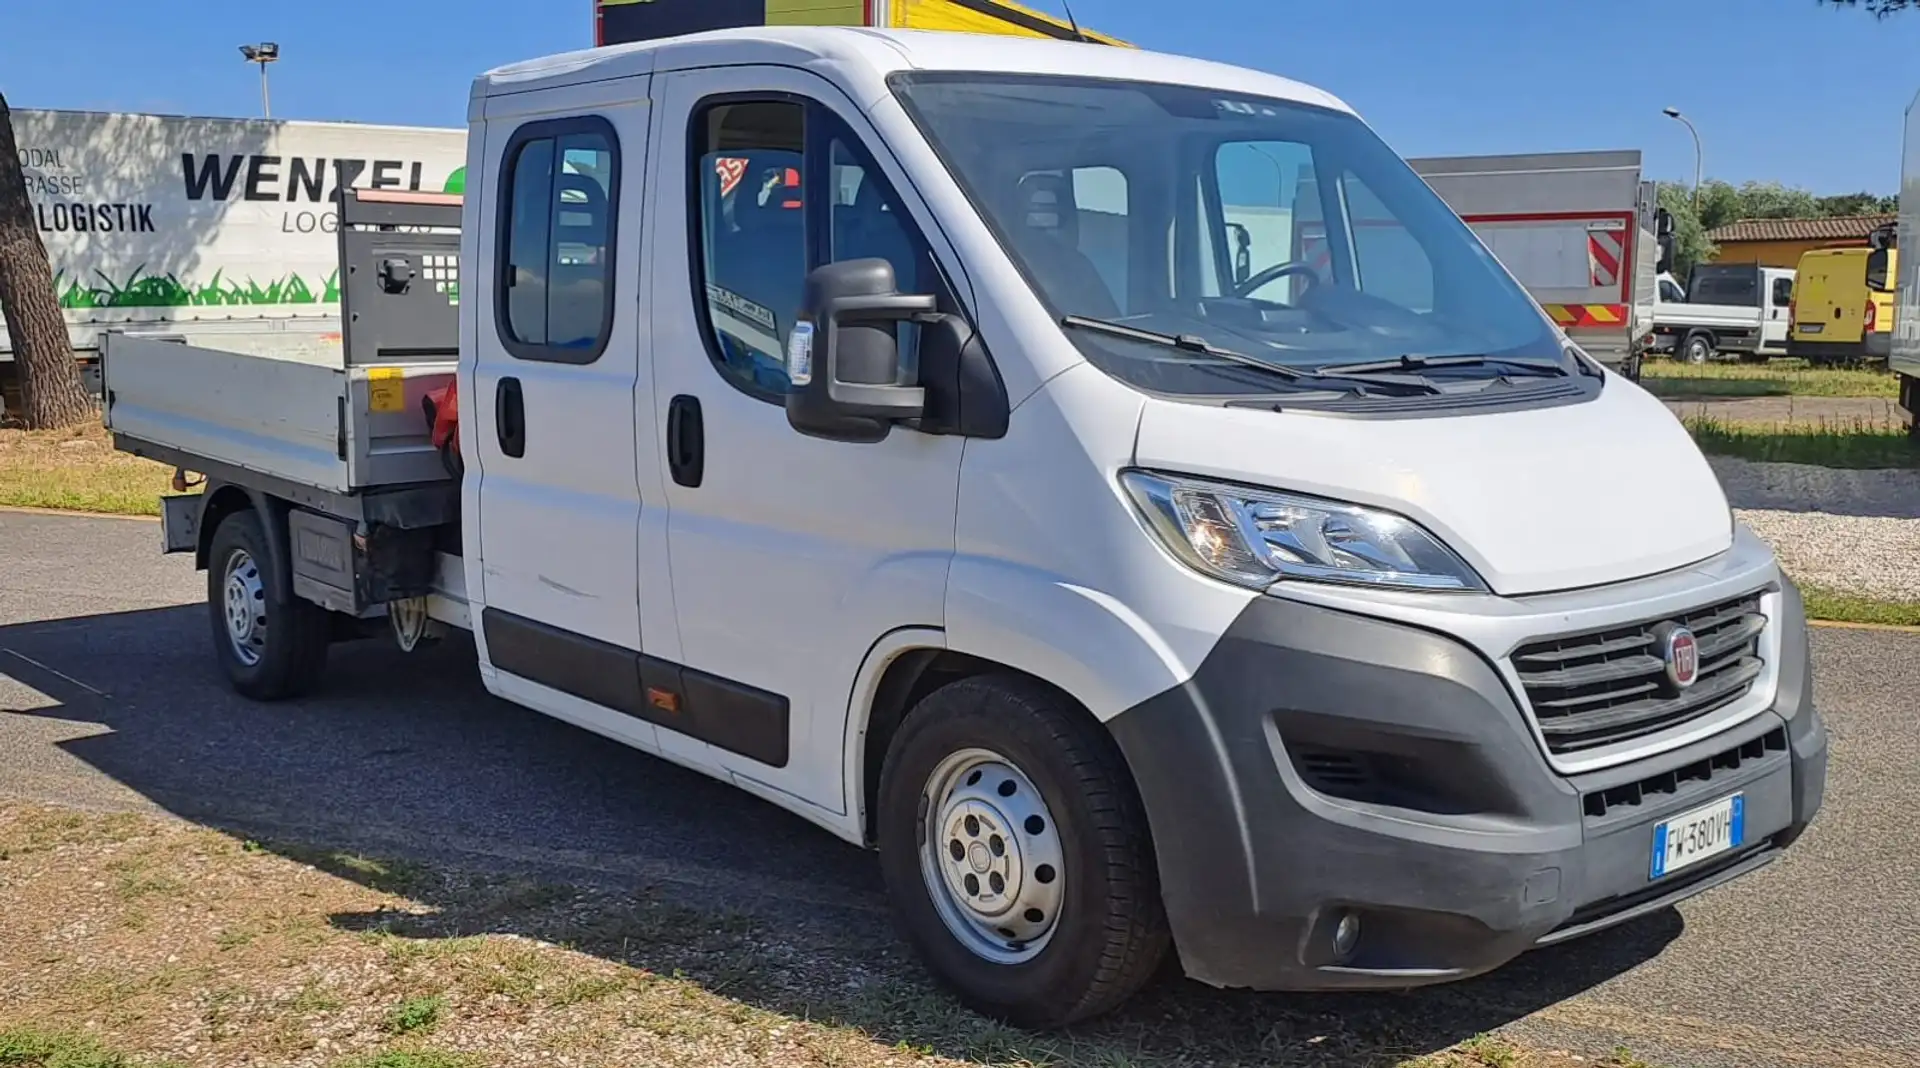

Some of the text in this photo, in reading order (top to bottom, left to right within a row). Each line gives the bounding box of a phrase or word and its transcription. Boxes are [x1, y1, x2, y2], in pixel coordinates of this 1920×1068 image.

[18, 148, 66, 169] ODAL
[24, 175, 83, 195] RASSE
[37, 202, 155, 232] LOGISTIK
